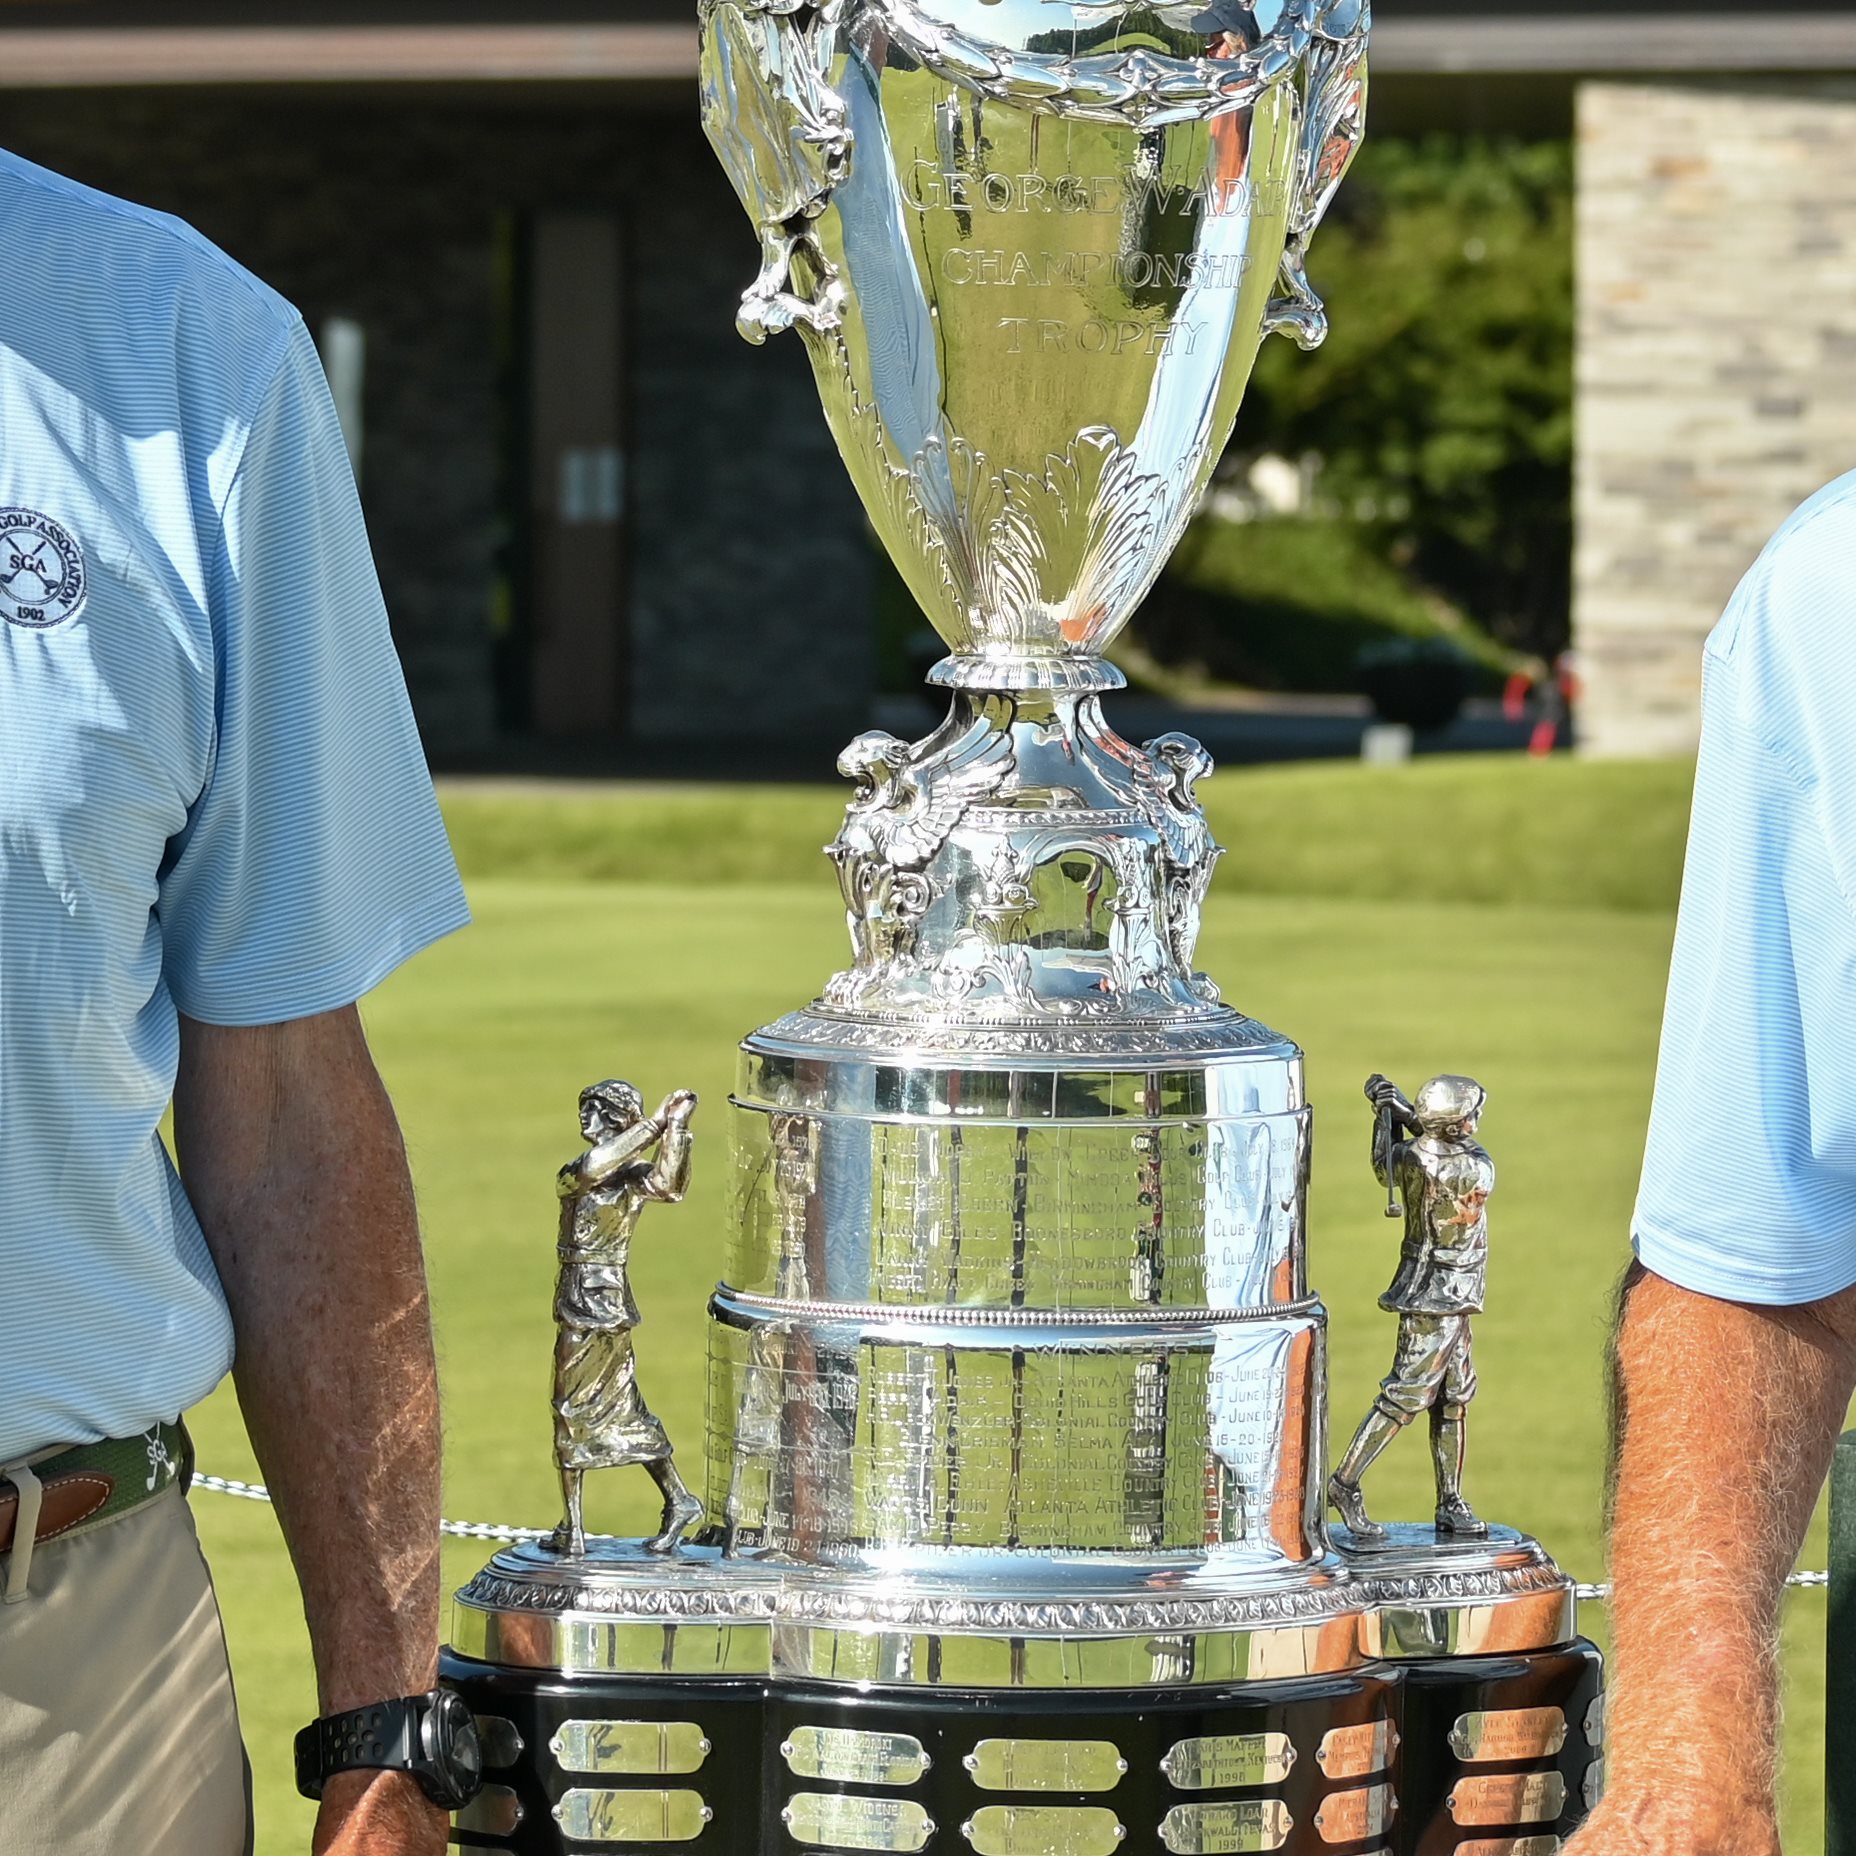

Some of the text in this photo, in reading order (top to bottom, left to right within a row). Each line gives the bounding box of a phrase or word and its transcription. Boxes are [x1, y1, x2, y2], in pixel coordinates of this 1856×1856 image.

[900, 159, 1119, 215] GEORGE
[941, 247, 1252, 289] CHAMPIONSHIP
[996, 316, 1208, 356] TROPHY
[8, 553, 48, 574] SGA
[35, 520, 82, 609] ASSOCIATION
[16, 605, 47, 622] 1902
[1212, 1217, 1246, 1238] CLUB
[1222, 1246, 1252, 1267] CLUB
[1032, 1340, 1190, 1361] WINNERS
[1228, 1386, 1261, 1404] JUNE
[1228, 1407, 1262, 1425] JUNE
[1109, 1473, 1177, 1493] COUNTRY
[1004, 1496, 1090, 1515] ATLANTA
[1093, 1495, 1178, 1515] ATHLETIC
